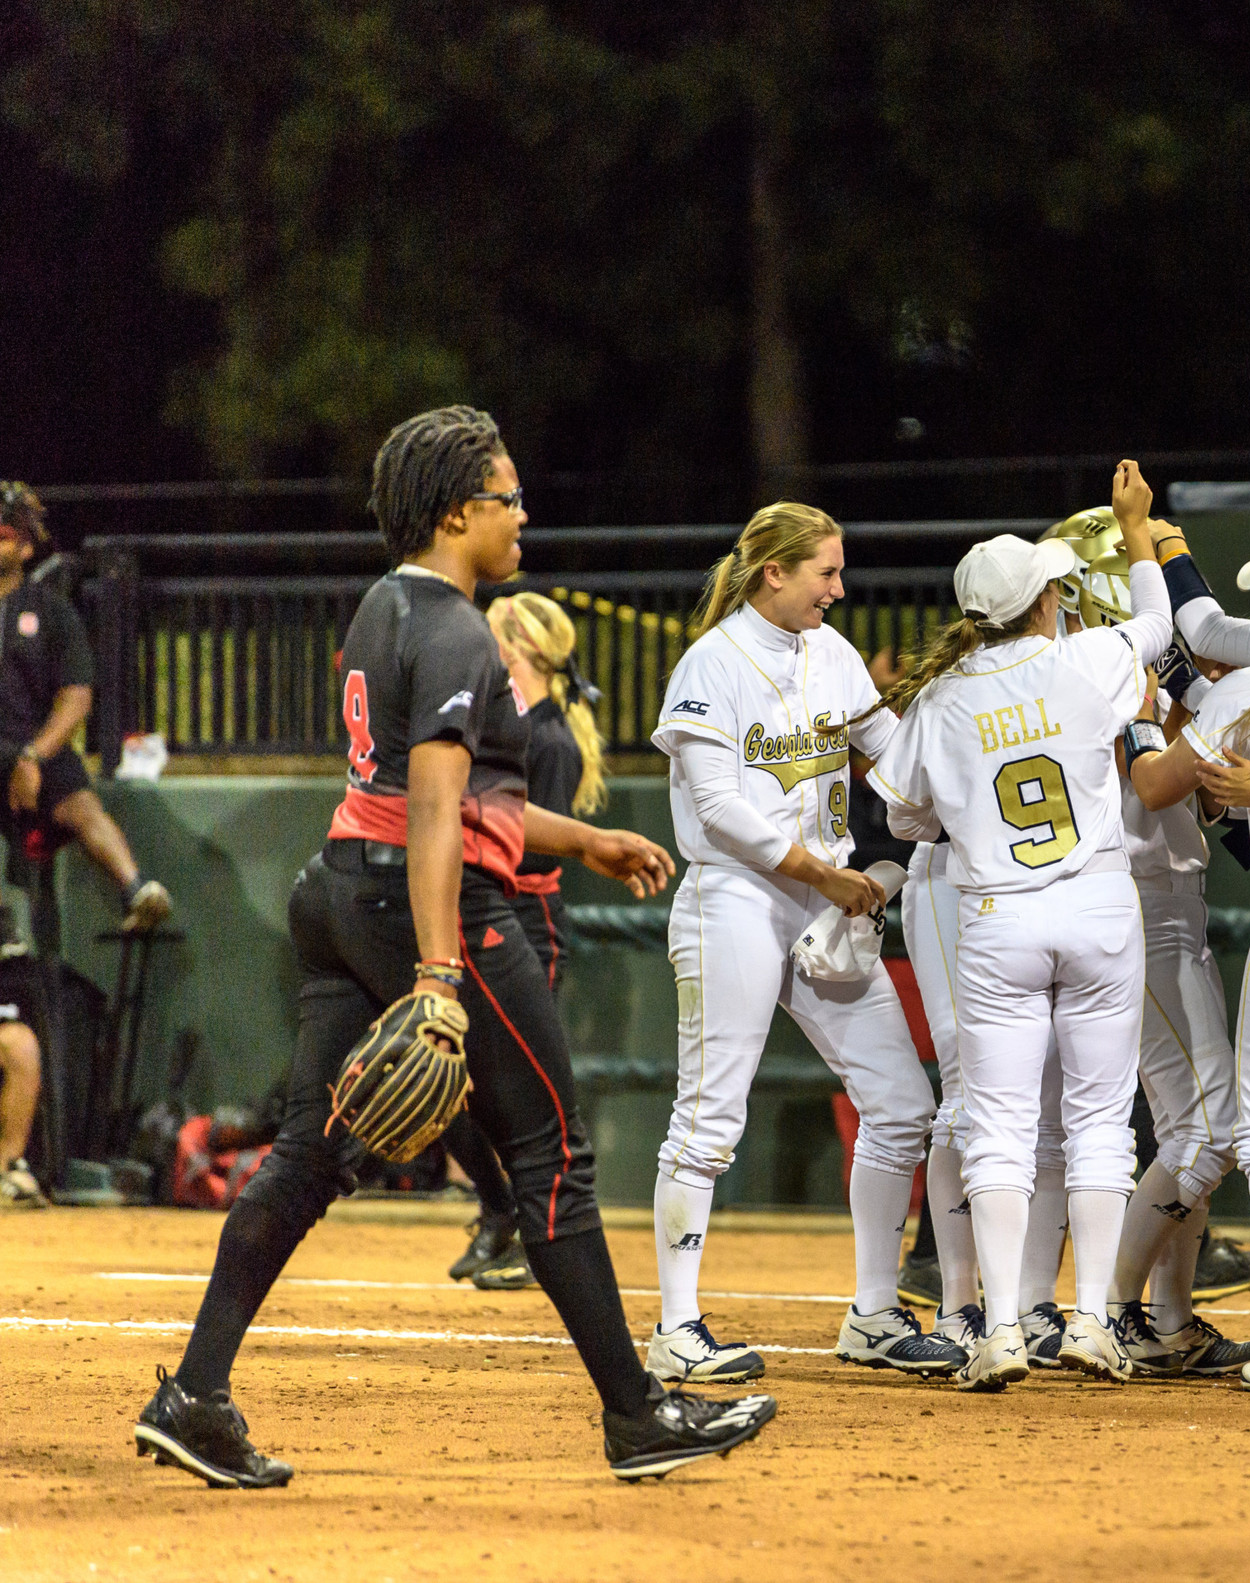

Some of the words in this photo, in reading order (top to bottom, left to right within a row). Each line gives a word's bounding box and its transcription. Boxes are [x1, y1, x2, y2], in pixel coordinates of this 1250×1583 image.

[670, 699, 711, 716] ACC
[973, 697, 1062, 754] BELL
[744, 722, 813, 764] Georgia
[828, 780, 847, 838] 9
[992, 753, 1081, 870] 9
